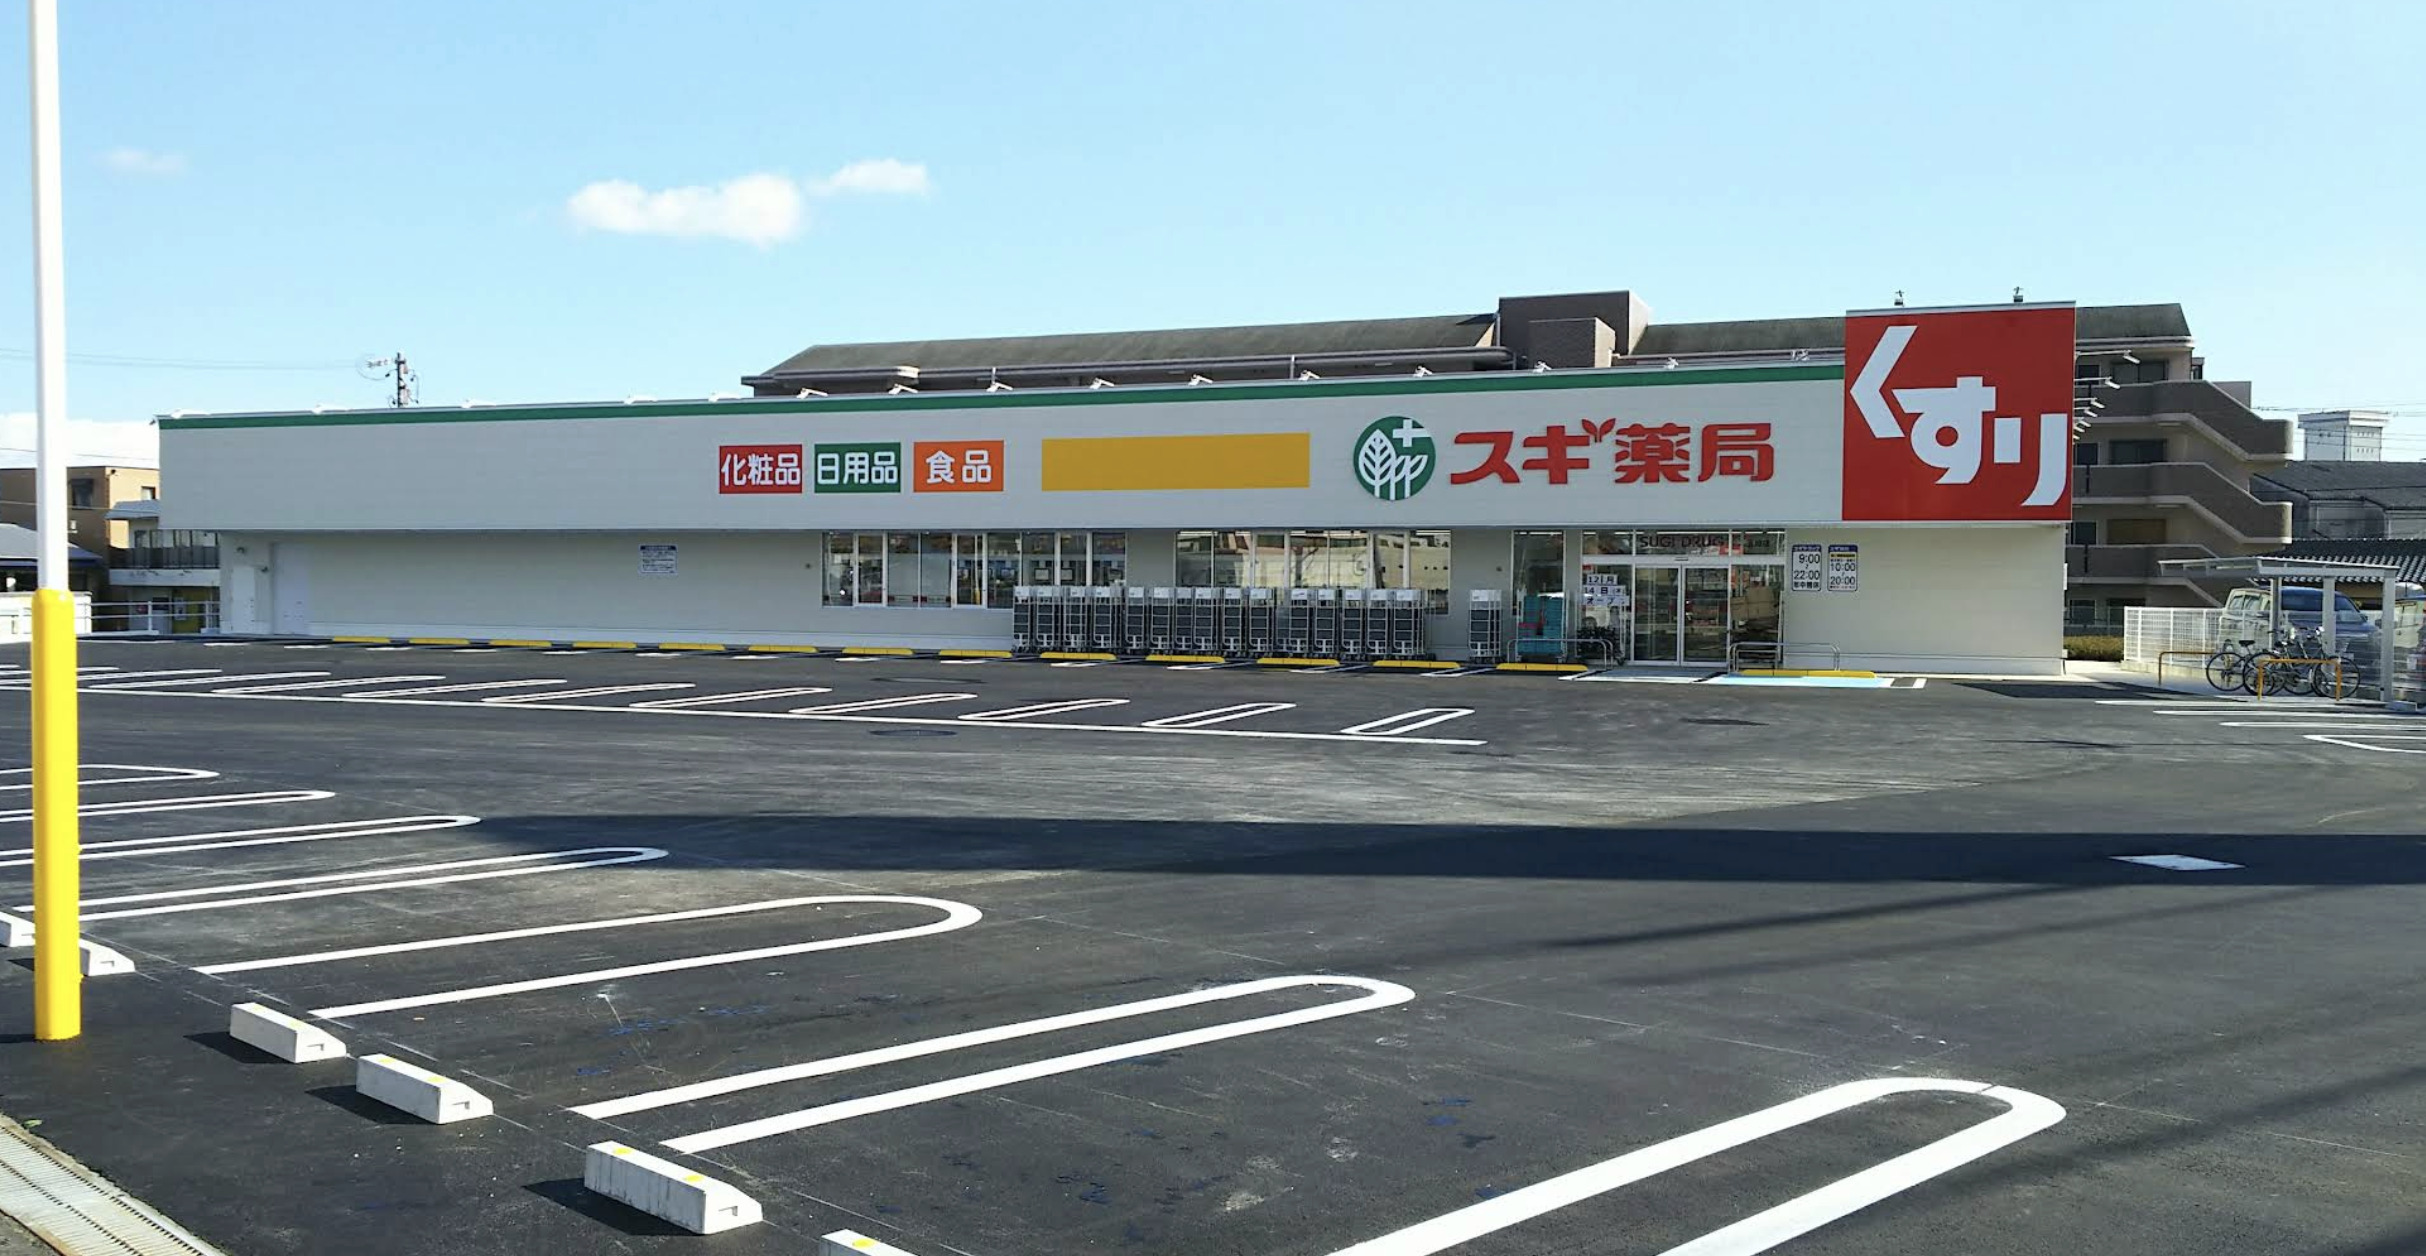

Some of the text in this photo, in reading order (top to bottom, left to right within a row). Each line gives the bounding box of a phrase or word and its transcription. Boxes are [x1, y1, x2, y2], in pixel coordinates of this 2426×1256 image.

[1850, 325, 2067, 506] くすり
[1451, 418, 1774, 485] スギ薬局
[720, 452, 801, 486] 化粧品
[818, 450, 898, 485] 日用品
[925, 449, 992, 484] 食品
[1640, 535, 1725, 548] SUGI DRUG
[1799, 554, 1820, 563] 9:00
[1830, 563, 1855, 571] 10:00
[1794, 571, 1820, 580] 22:00
[1830, 577, 1855, 585] 20:00
